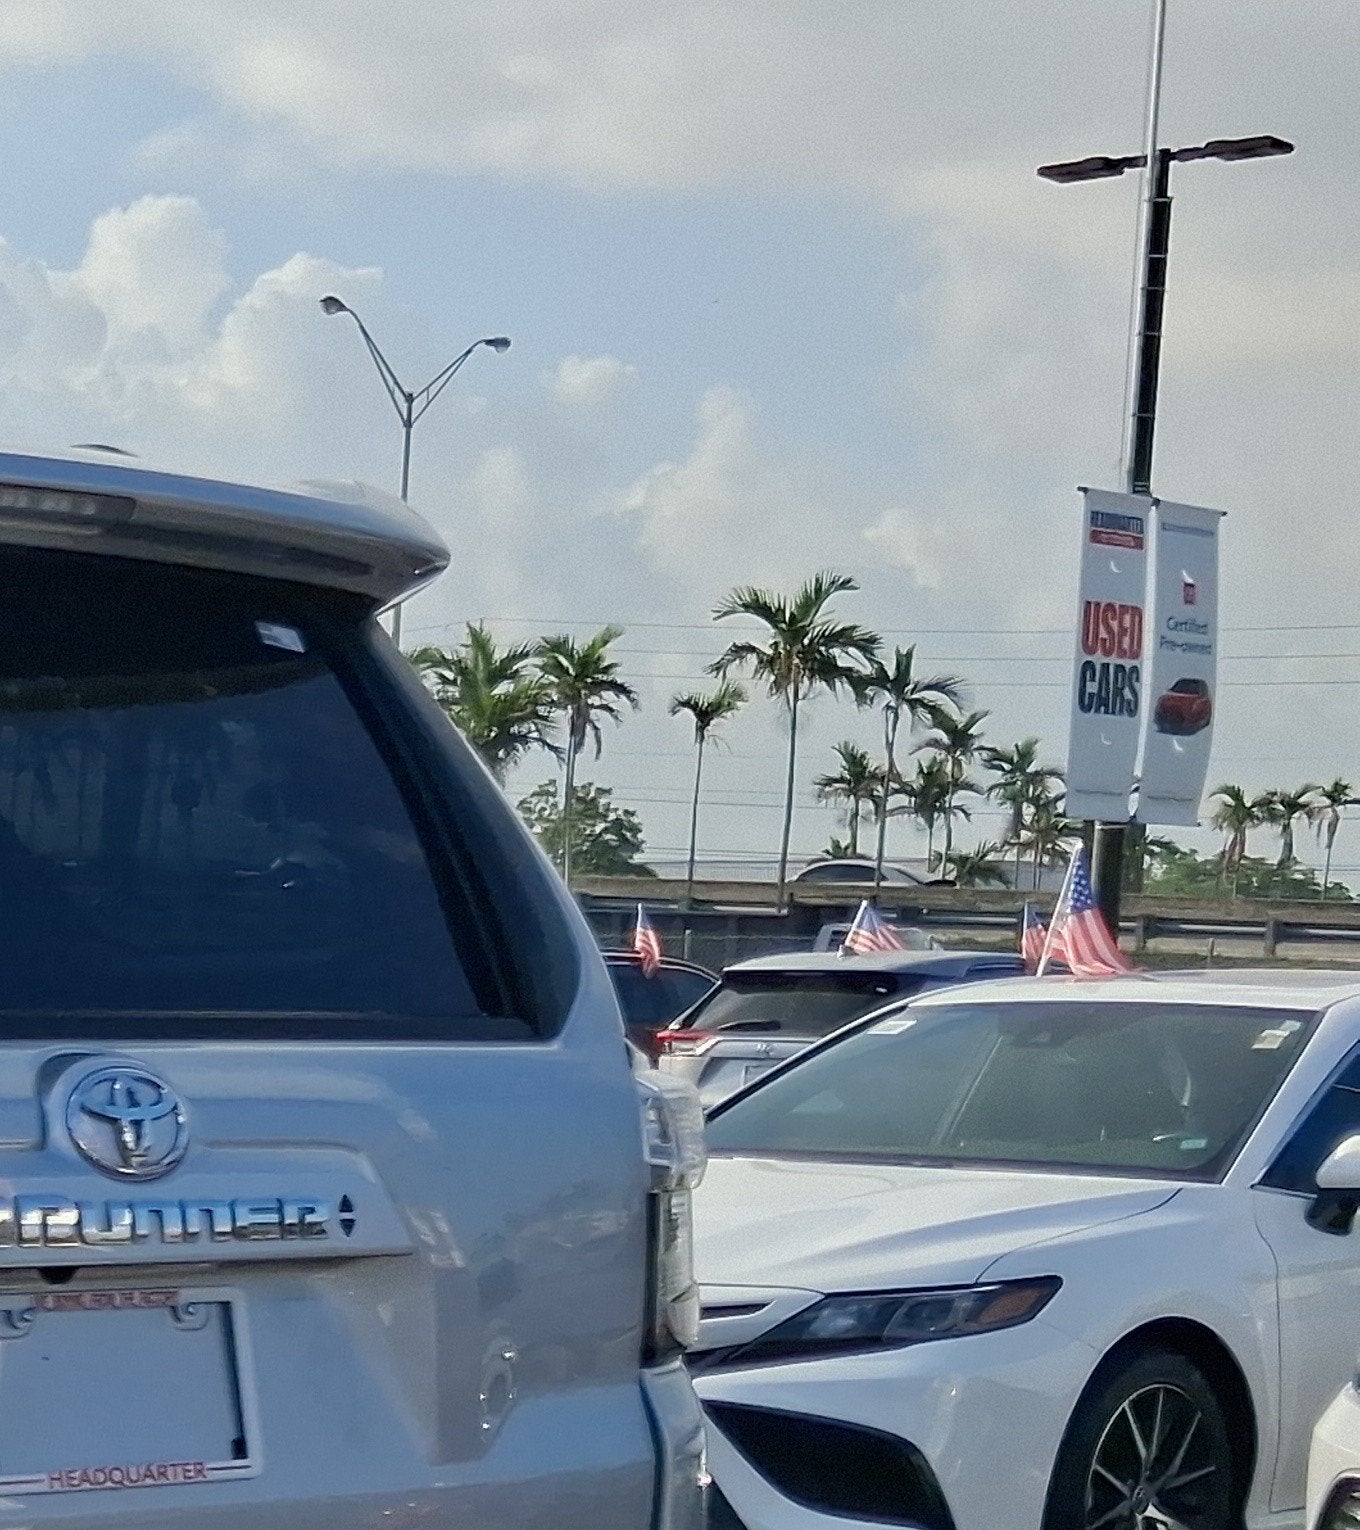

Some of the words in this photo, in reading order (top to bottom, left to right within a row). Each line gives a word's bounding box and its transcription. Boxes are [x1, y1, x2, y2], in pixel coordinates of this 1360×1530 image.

[1081, 600, 1143, 660] USED
[1078, 660, 1140, 718] CARS
[46, 1461, 207, 1489] HEADQUARTER
